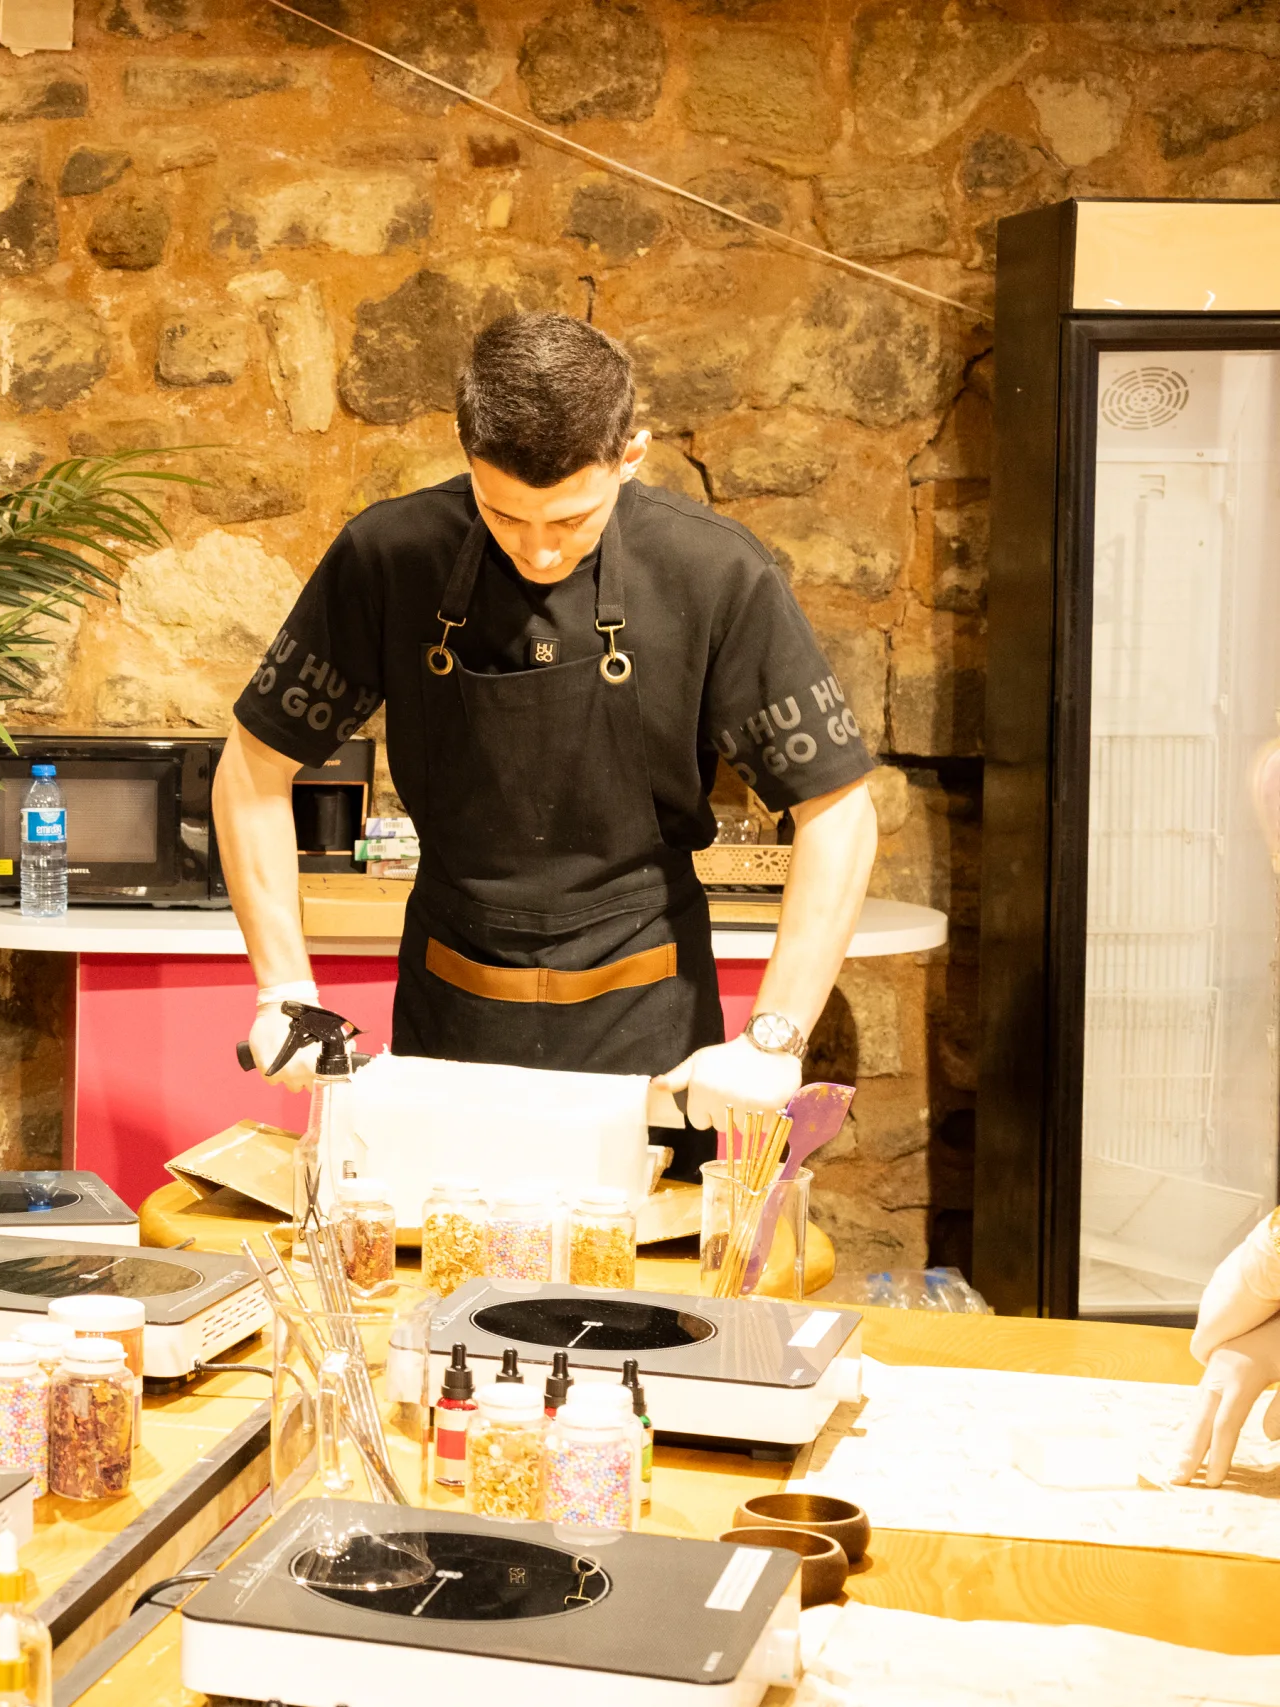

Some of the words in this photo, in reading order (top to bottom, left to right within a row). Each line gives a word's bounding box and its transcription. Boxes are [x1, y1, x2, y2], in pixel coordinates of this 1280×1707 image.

[536, 642, 554, 654] HU
[281, 686, 333, 731] GO
[336, 717, 363, 742] G
[299, 653, 348, 699] HU
[353, 686, 380, 715] H
[712, 729, 738, 760] U
[746, 695, 802, 745] HU
[810, 675, 846, 714] HU
[732, 762, 757, 787] O
[762, 732, 818, 776] GO
[827, 707, 861, 746] GO
